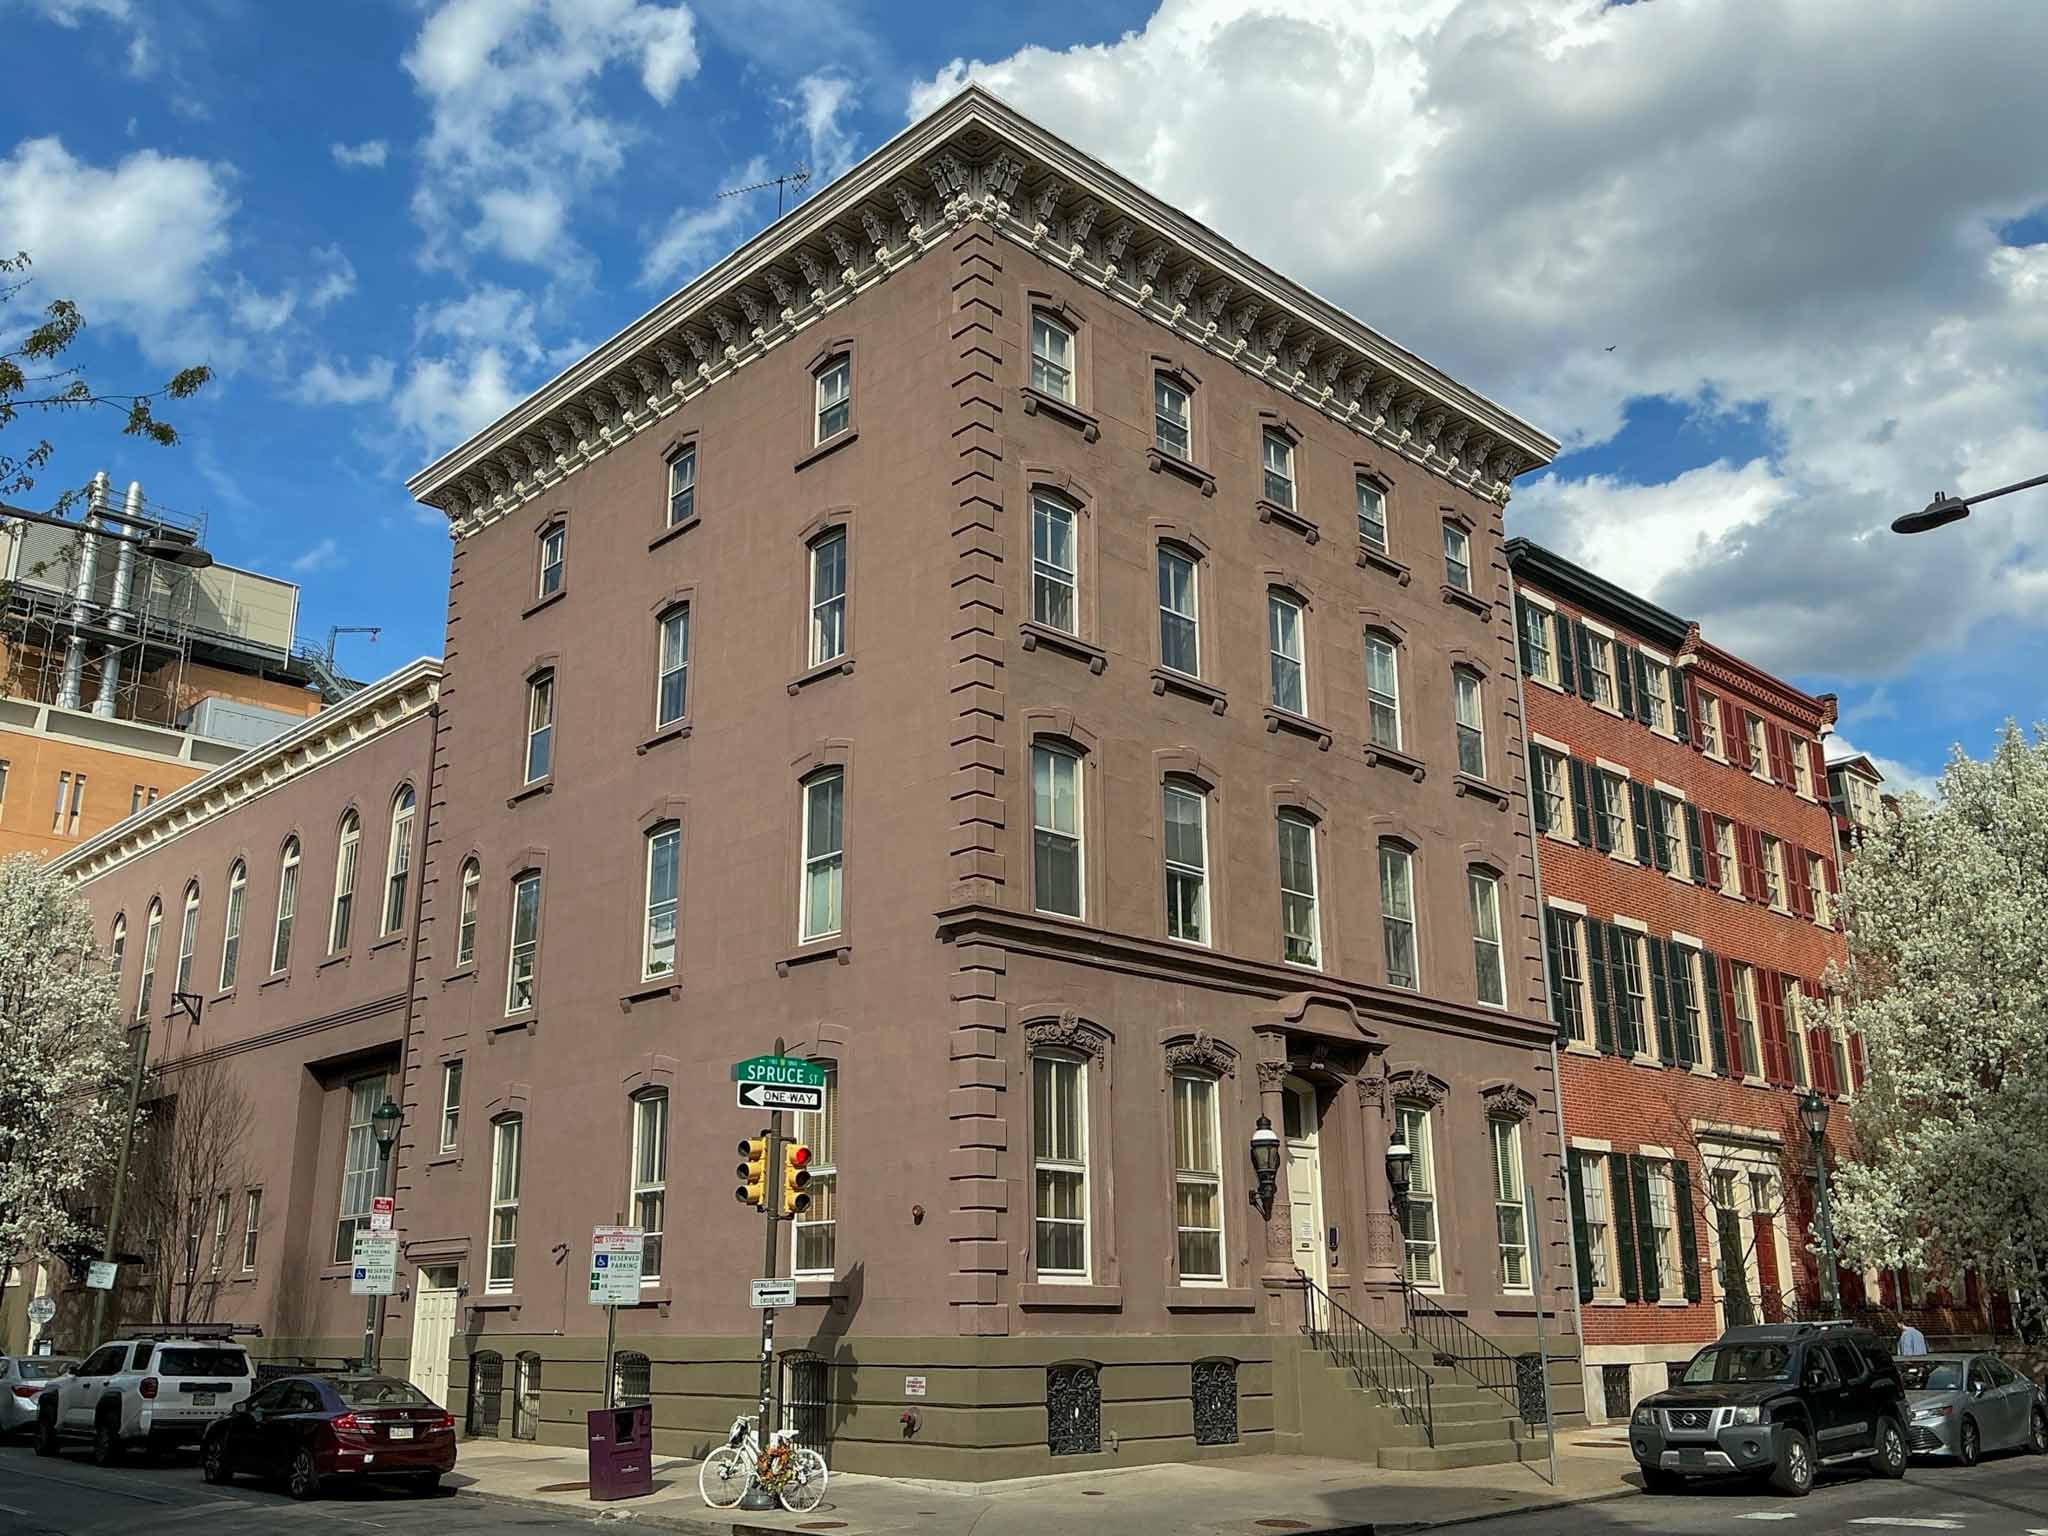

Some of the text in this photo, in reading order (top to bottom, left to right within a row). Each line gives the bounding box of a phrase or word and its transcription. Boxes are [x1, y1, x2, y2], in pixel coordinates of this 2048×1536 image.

[748, 1065, 818, 1084] SPRUCE ST
[764, 1091, 813, 1103] ONE WAY
